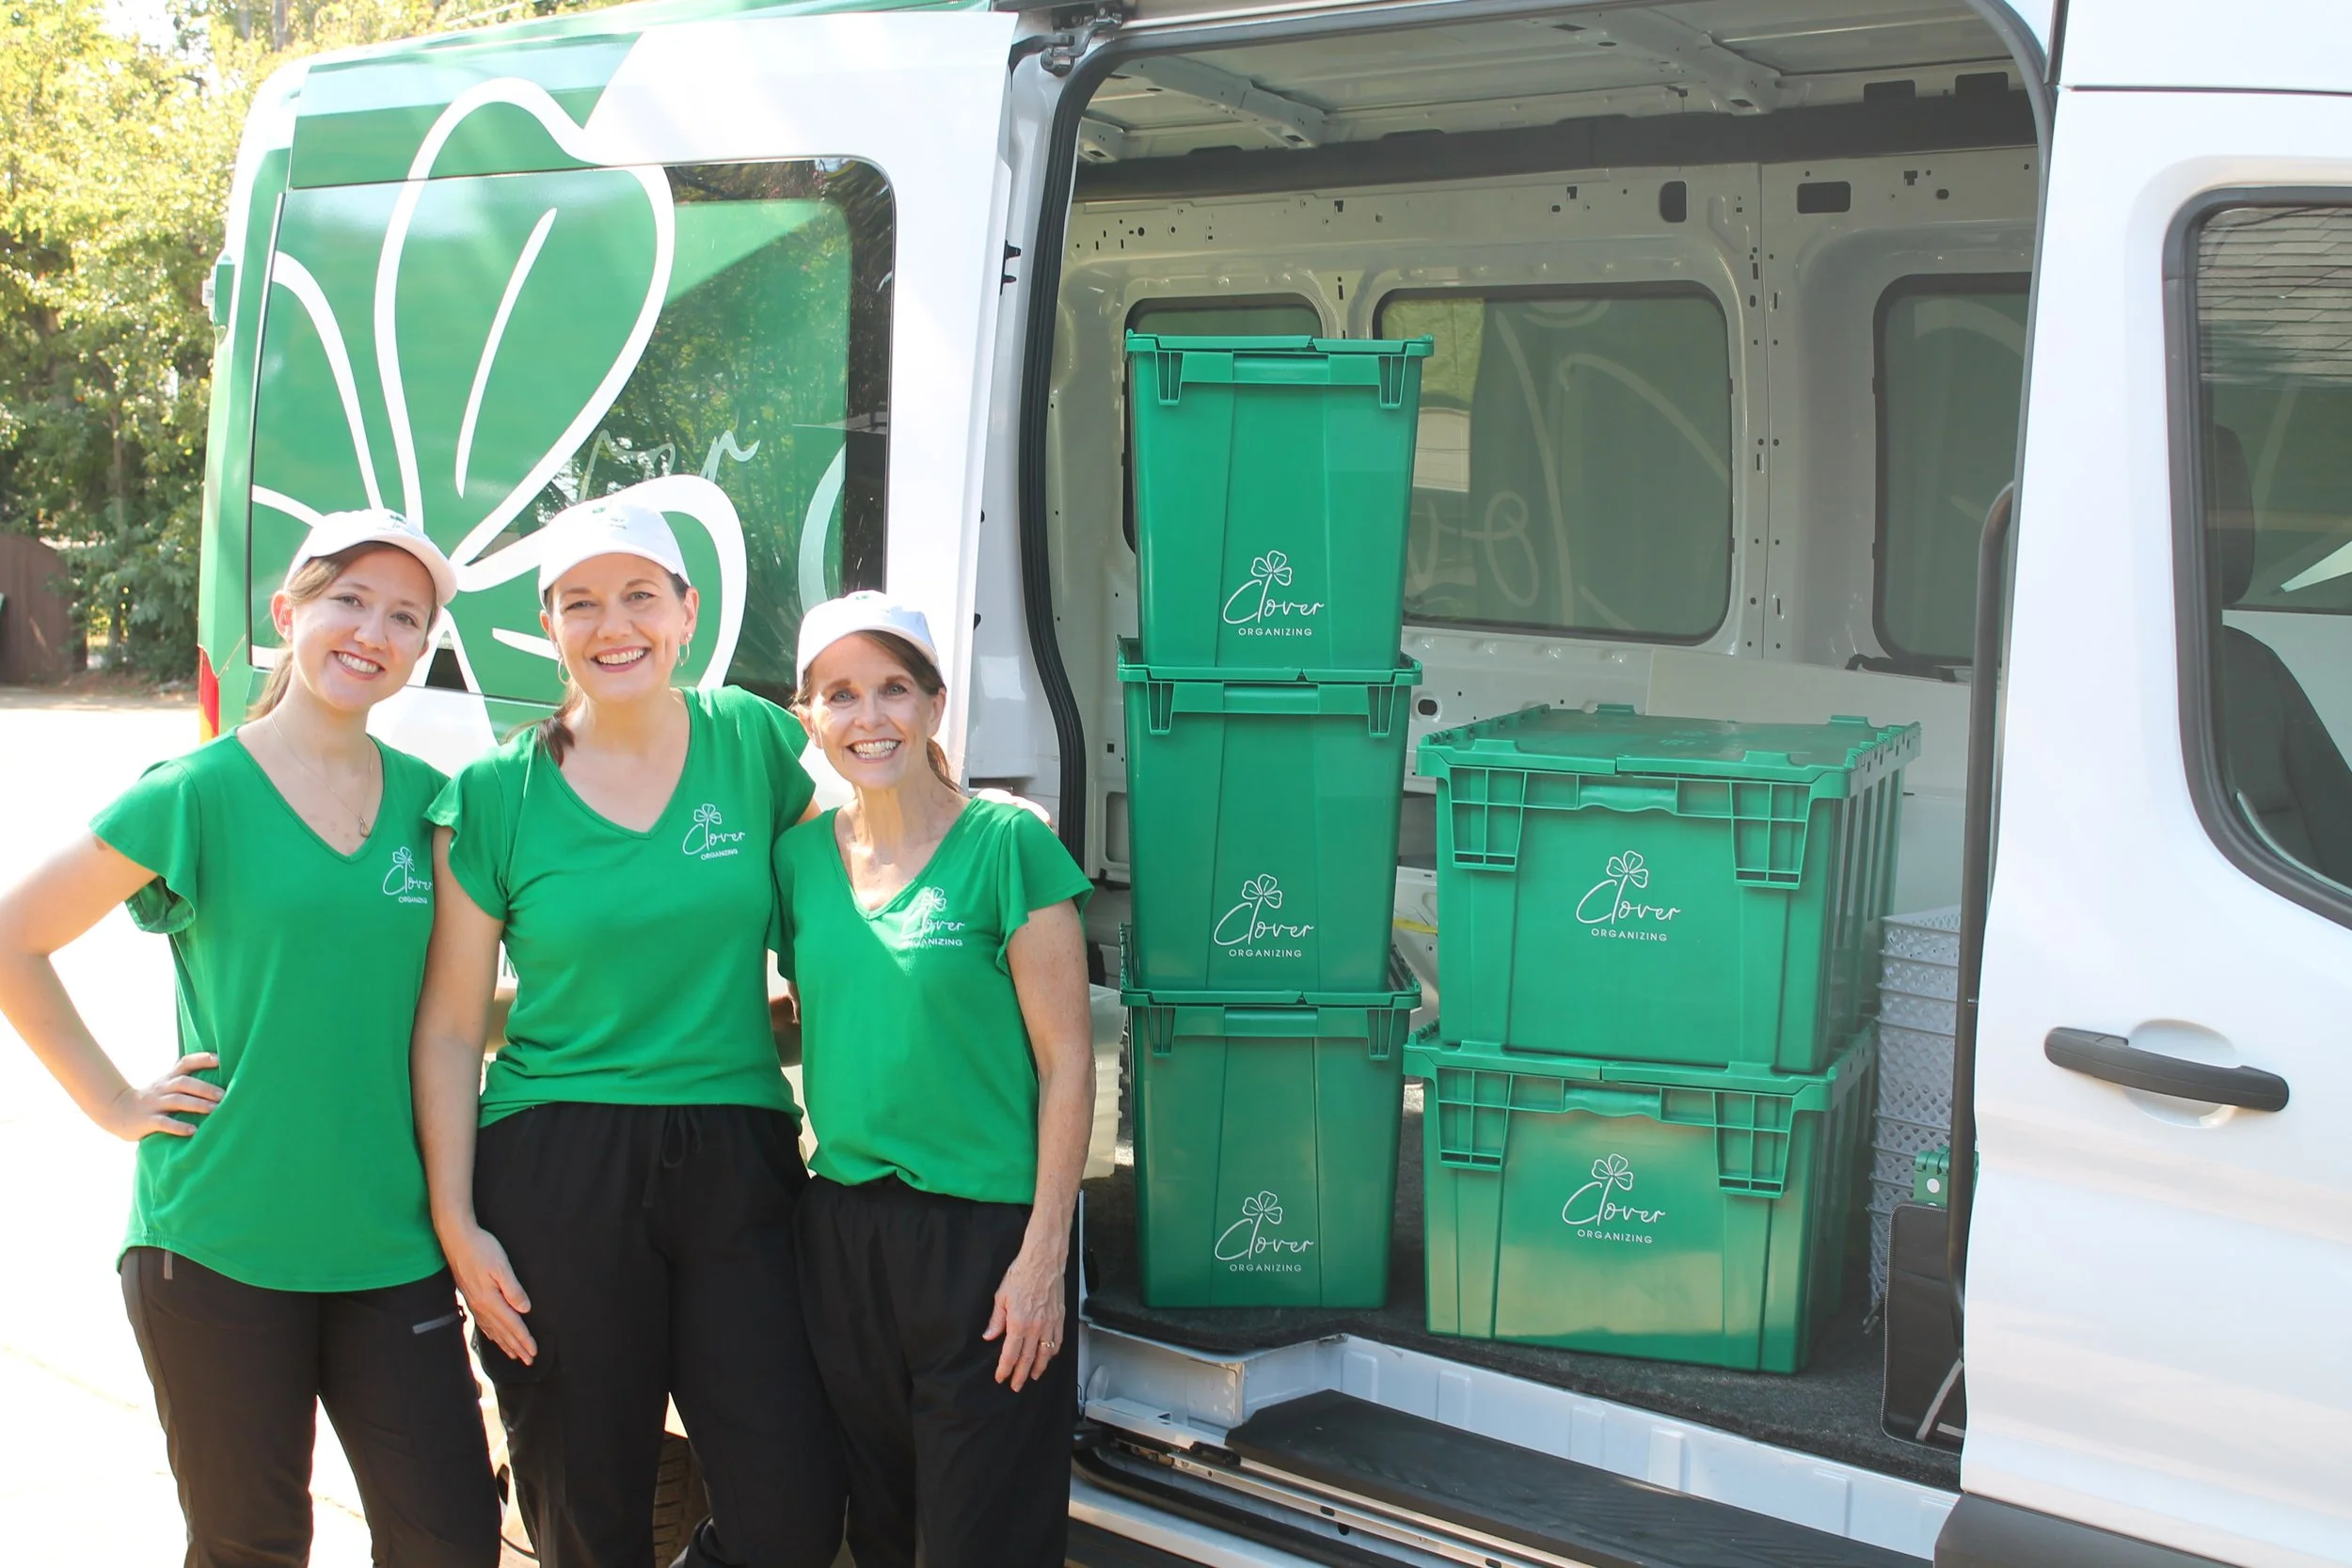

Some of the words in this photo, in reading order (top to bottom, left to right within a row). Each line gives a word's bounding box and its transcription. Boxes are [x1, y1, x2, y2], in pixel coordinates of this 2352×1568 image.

[1222, 574, 1325, 625] Clover
[1237, 626, 1313, 637] ORGANIZING
[682, 816, 746, 856] Clover
[700, 848, 739, 861] ORGANIZING
[1575, 874, 1682, 926] Clover
[1213, 895, 1315, 946] Clover
[1590, 927, 1668, 942] ORGANIZING
[1228, 948, 1303, 958] ORGANIZING
[1562, 1176, 1666, 1227] Clover
[1214, 1212, 1314, 1261] Clover
[1576, 1228, 1653, 1243] ORGANIZING
[1229, 1263, 1303, 1273] ORGANIZING
